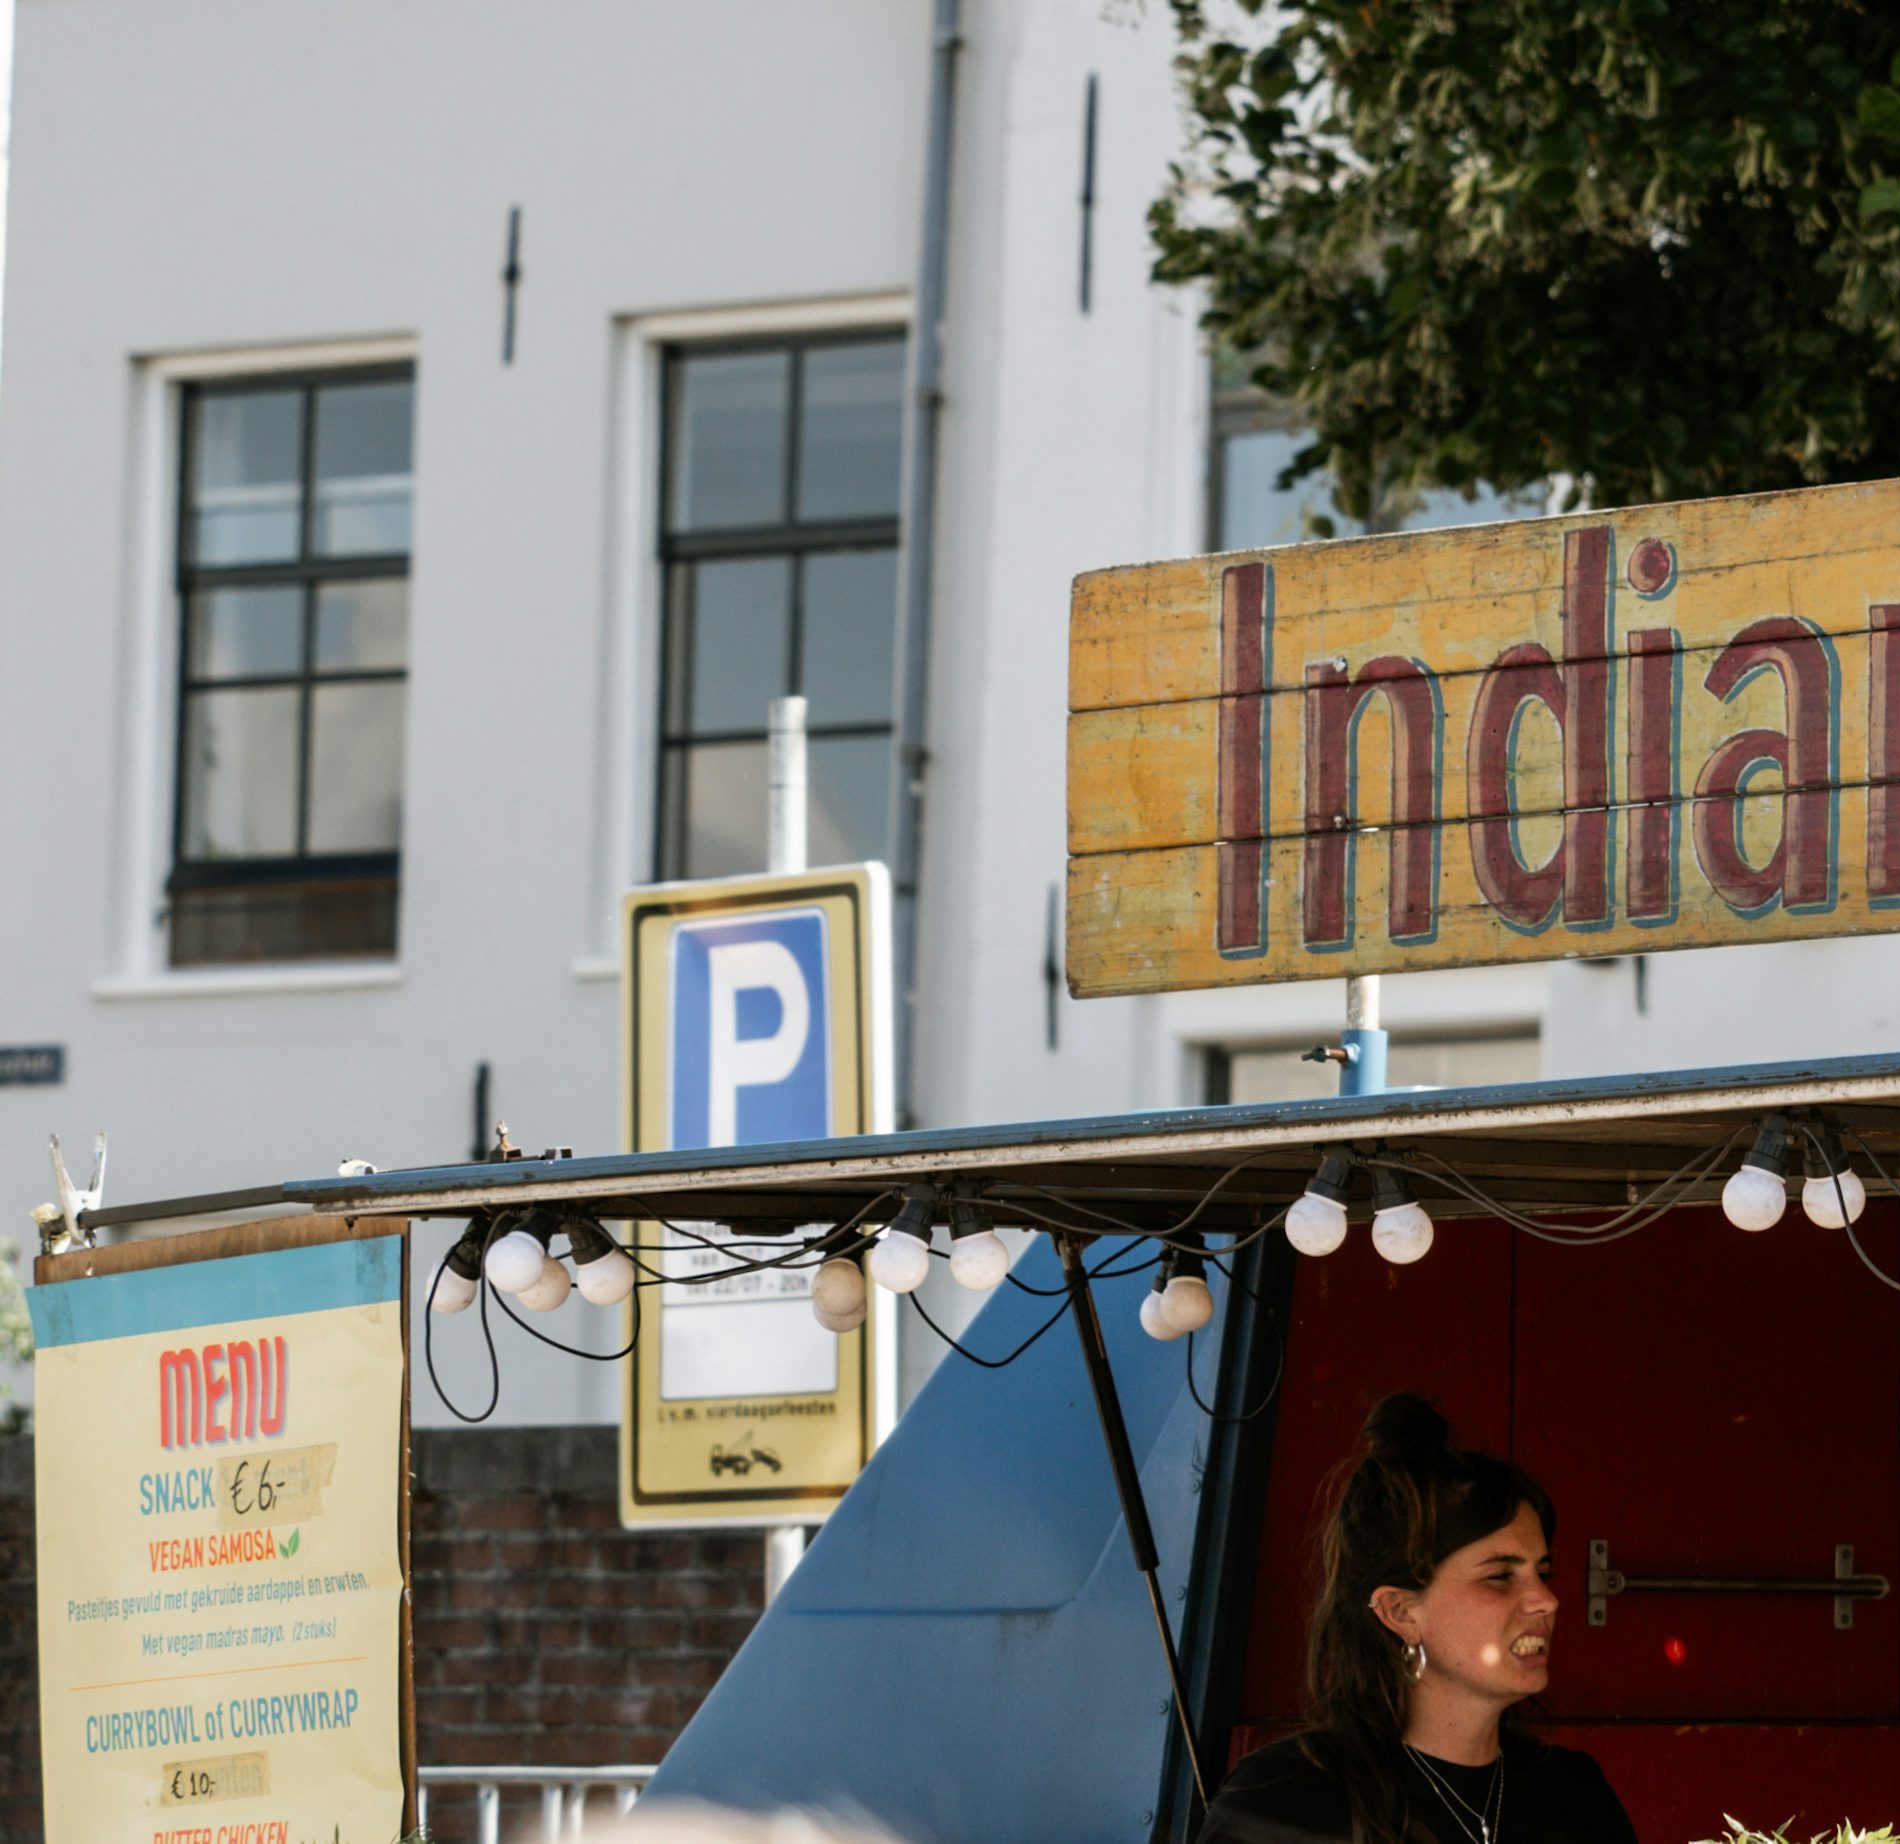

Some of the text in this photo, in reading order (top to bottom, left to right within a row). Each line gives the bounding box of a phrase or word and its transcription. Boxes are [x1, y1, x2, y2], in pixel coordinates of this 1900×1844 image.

[708, 940, 810, 1149] P
[160, 1336, 286, 1450] MENU
[140, 1467, 216, 1515] SNACK
[149, 1529, 277, 1573] VEGAN SAMOSA
[67, 1571, 370, 1623] Pasteitjes gevuld met gekruide aardappel en erwten.
[142, 1633, 163, 1656] Met
[167, 1633, 203, 1658] vegan
[206, 1626, 248, 1649] madras
[251, 1624, 285, 1649] mayo.
[86, 1688, 359, 1754] CURRYBOWL of CURRYWRAP
[217, 1821, 289, 1844] CHICKEN
